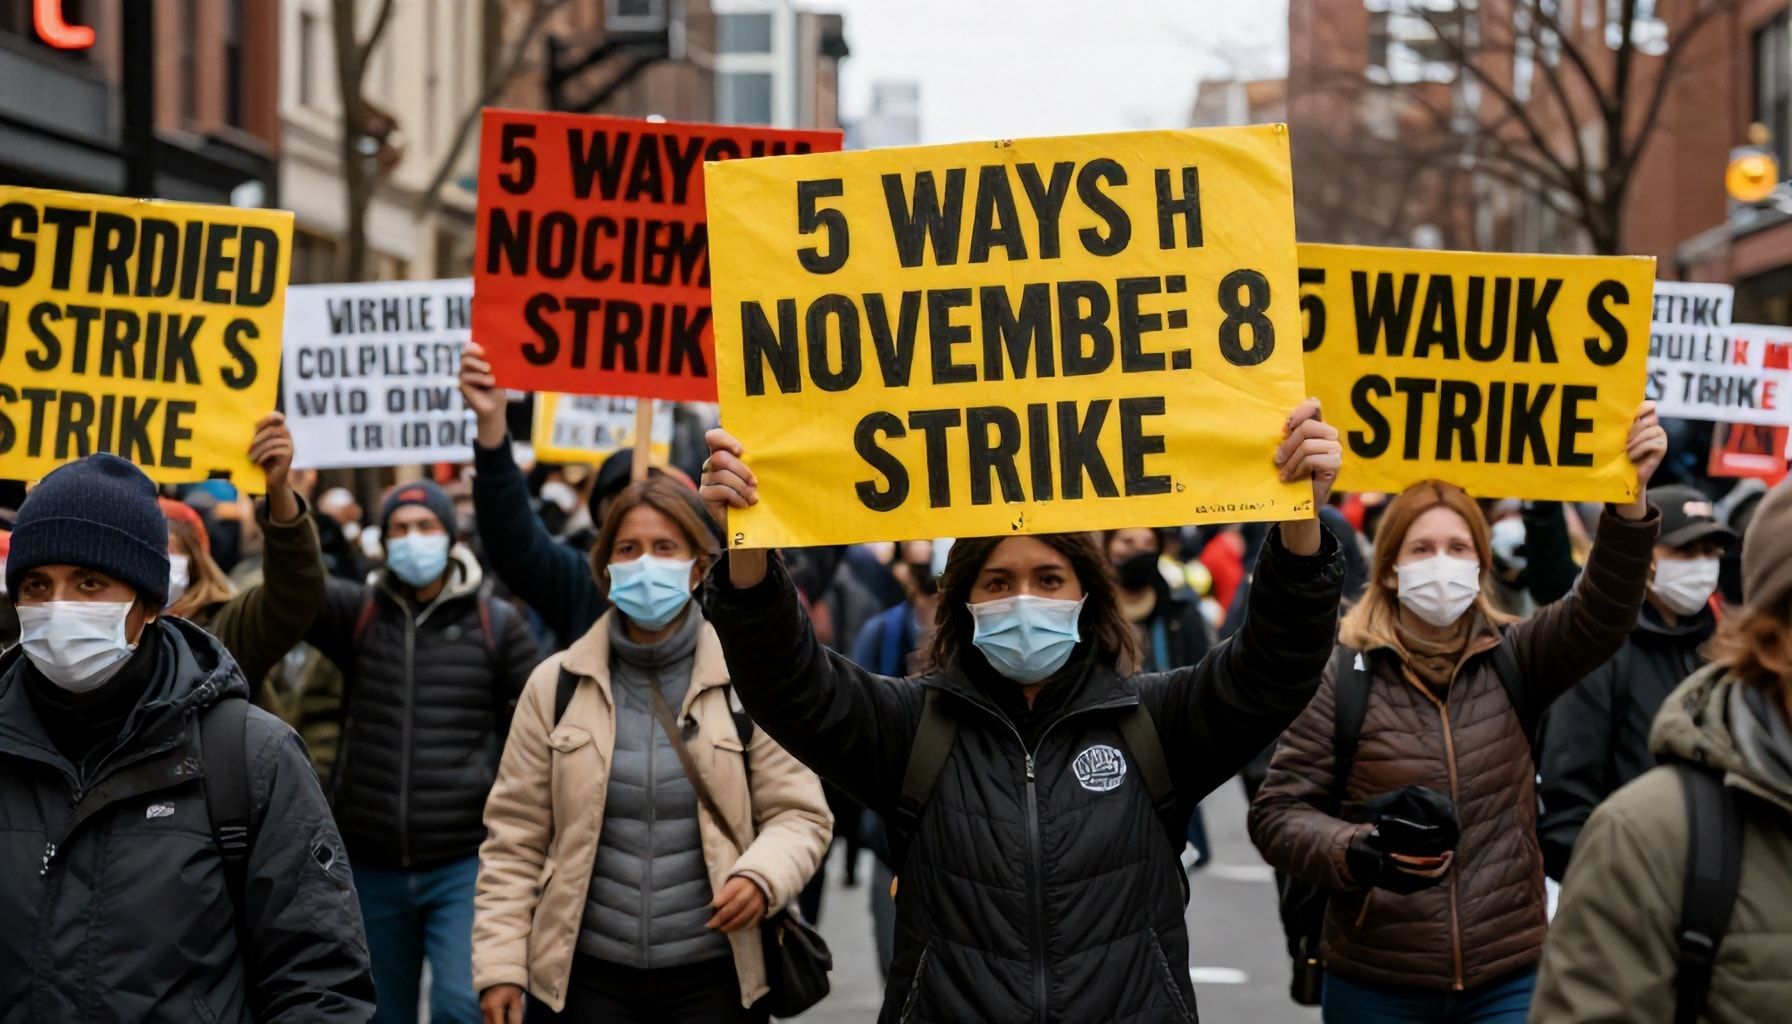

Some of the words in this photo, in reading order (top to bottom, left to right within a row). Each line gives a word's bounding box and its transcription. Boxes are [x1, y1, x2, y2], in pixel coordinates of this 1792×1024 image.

[498, 123, 536, 195] 5
[796, 178, 849, 275] 5
[881, 158, 1132, 269] WAYS
[1154, 166, 1204, 249] H
[25, 302, 206, 385] STRIK
[521, 292, 711, 378] STRIK
[1218, 268, 1275, 367] 8
[1351, 270, 1563, 363] WAUK
[1584, 279, 1630, 366] S
[854, 396, 1172, 513] STRIKE
[1348, 374, 1598, 467] STRIKE
